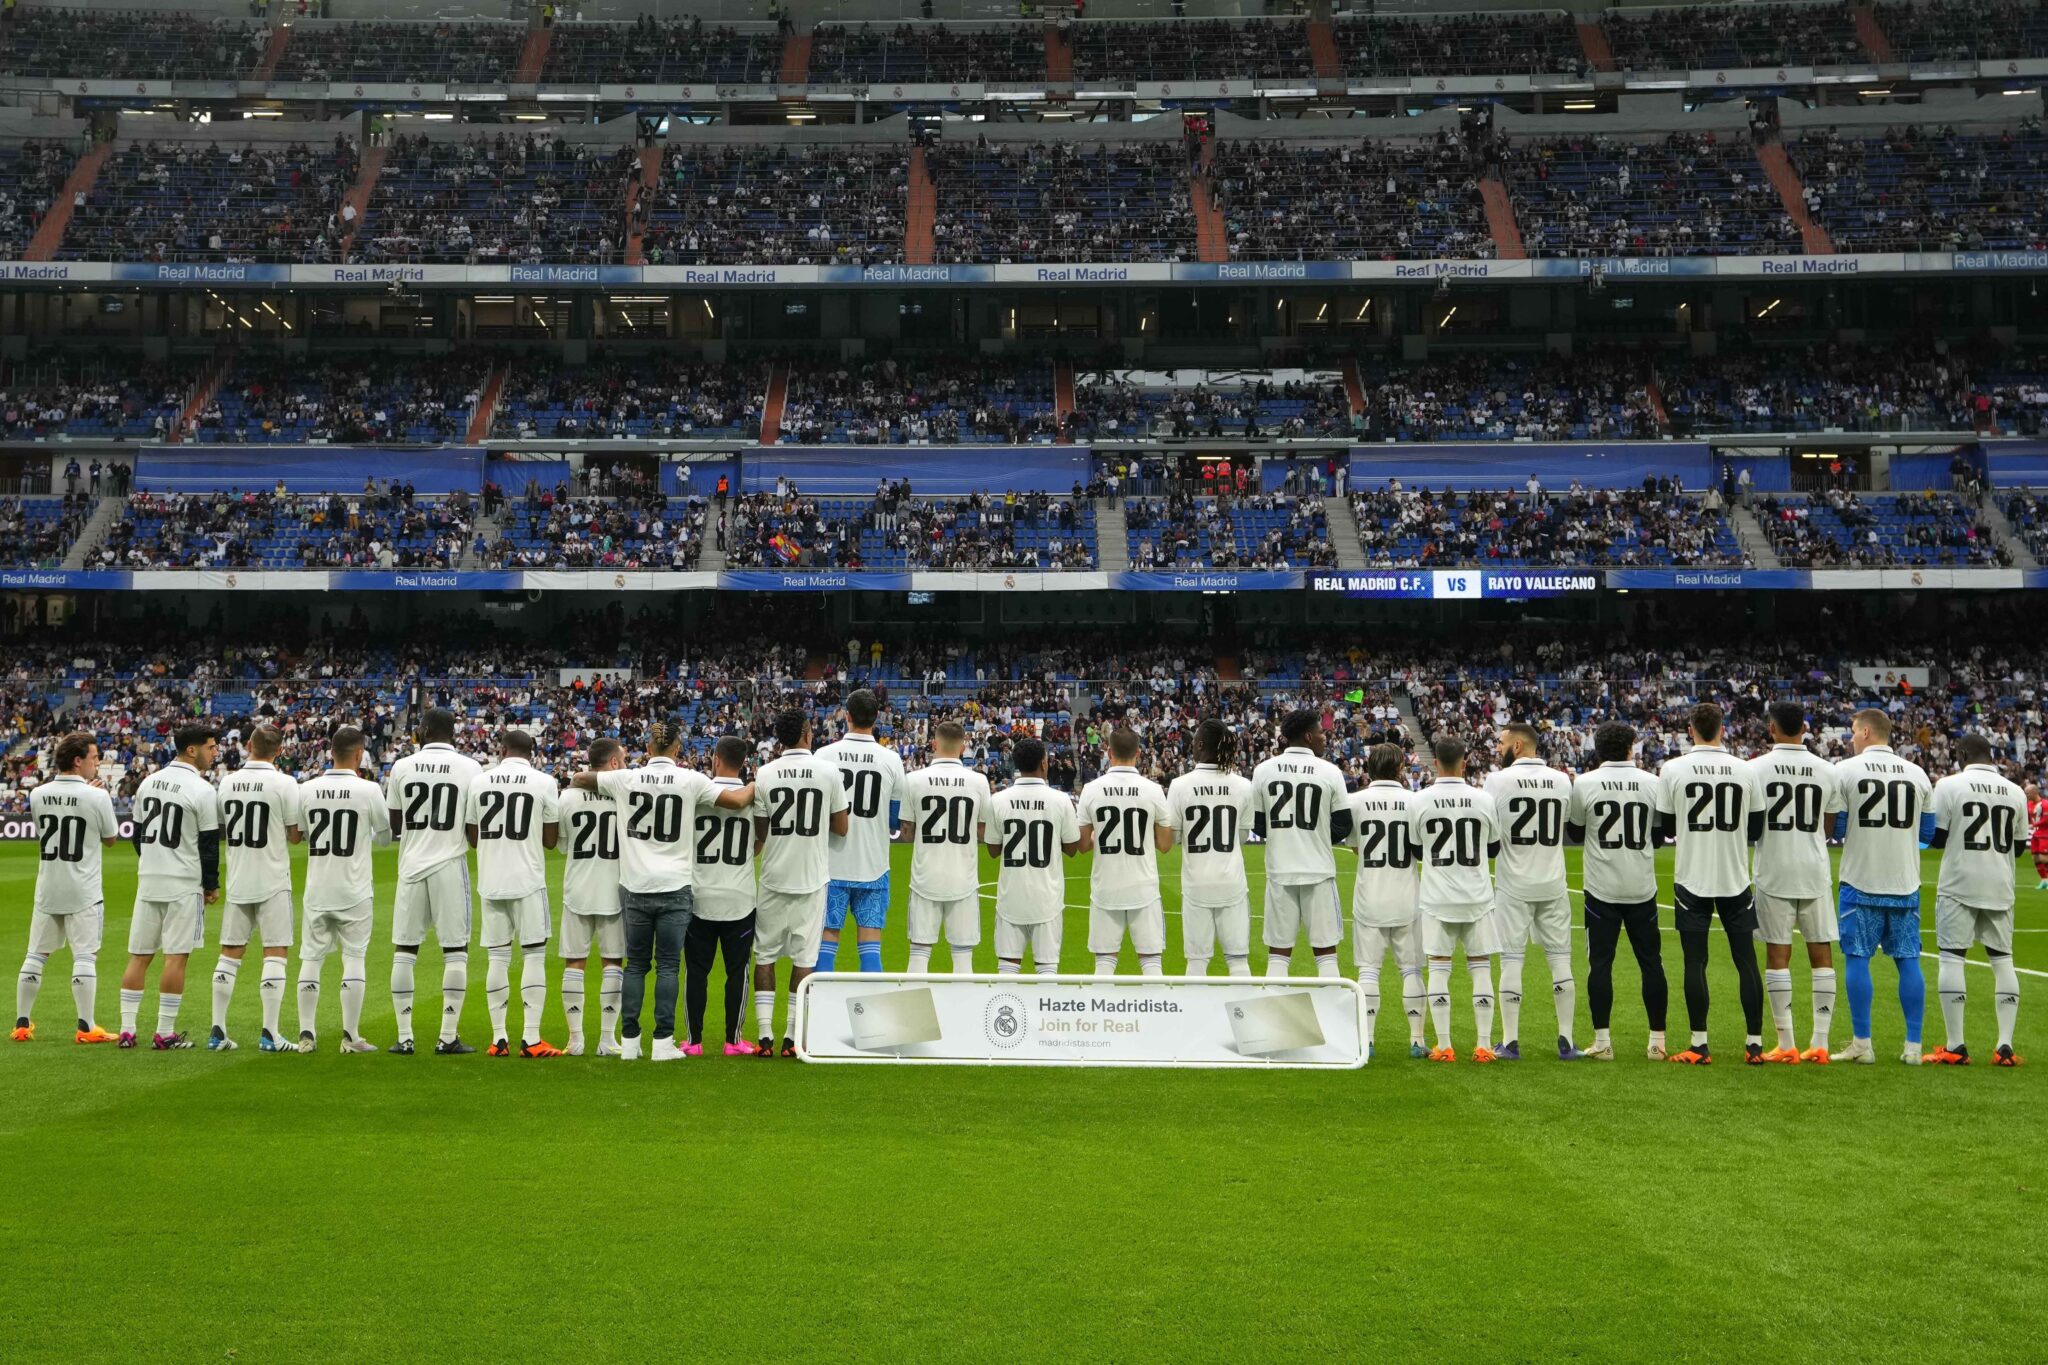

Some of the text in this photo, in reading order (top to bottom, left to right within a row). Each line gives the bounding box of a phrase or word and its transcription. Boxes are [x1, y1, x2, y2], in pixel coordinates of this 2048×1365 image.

[1617, 258, 1669, 273] Madrid
[1762, 259, 1858, 273] Real Madrid
[1954, 253, 2048, 267] Real Madrid
[14, 266, 68, 278] Madrid
[158, 265, 245, 279] Real Madrid
[334, 268, 424, 281] Real Madrid
[512, 267, 597, 280] Real Madrid
[686, 270, 776, 282] Real Madrid
[864, 267, 949, 280] Real Madrid
[1037, 268, 1127, 281] Real Madrid
[1219, 264, 1305, 277] Real Madrid
[1396, 263, 1488, 276] Real Madrid
[2, 574, 66, 584] Real Madrid
[395, 576, 457, 586] Real Madrid
[783, 576, 846, 586] Real Madrid
[1174, 576, 1237, 587] Real Madrid
[1314, 577, 1425, 591] REAL MADRID C.F.
[1447, 577, 1467, 592] VS
[1488, 576, 1596, 590] RAYO VALLECANO
[1676, 573, 1741, 584] Real Madrid
[838, 752, 859, 762] VINI
[415, 763, 436, 774] VINI
[777, 769, 797, 779] VINI
[1277, 763, 1298, 774] VINI
[1692, 765, 1715, 775] VINI
[1774, 764, 1795, 775] VINI
[1864, 763, 1887, 773] VINI
[490, 774, 510, 784] VINI
[928, 777, 950, 787] VINI
[1517, 778, 1538, 789] VINI
[232, 782, 250, 792] VINI
[1103, 786, 1124, 797] VINI
[1193, 786, 1213, 796] VINI
[1600, 781, 1623, 791] VINI
[1969, 783, 1992, 795] VINI
[43, 795, 62, 806] VINI
[315, 789, 335, 799] VINI
[404, 782, 459, 831] 20
[1010, 800, 1030, 810] VINI
[1267, 780, 1323, 831] 20
[1365, 801, 1388, 811] VINI
[1433, 798, 1456, 809] VINI
[1685, 782, 1743, 832] 20
[1766, 781, 1823, 833] 20
[1857, 778, 1916, 829] 20
[479, 791, 534, 840] 20
[626, 791, 683, 842] 20
[769, 787, 823, 837] 20
[140, 797, 184, 849] 20
[224, 800, 270, 848] 20
[921, 795, 974, 844] 20
[1508, 797, 1562, 847] 20
[1594, 800, 1649, 850] 20
[308, 808, 359, 857] 20
[1096, 805, 1148, 856] 20
[1185, 804, 1238, 853] 20
[1963, 801, 2016, 854] 20
[39, 814, 86, 862] 20
[571, 811, 618, 860] 20
[695, 815, 750, 866] 20
[1425, 817, 1482, 867] 20
[1003, 818, 1054, 868] 20
[1360, 819, 1411, 868] 20
[1039, 998, 1183, 1013] Hazte Madridista.
[1038, 1018, 1140, 1033] Join for Real
[1038, 1039, 1111, 1048] madridistas.com
